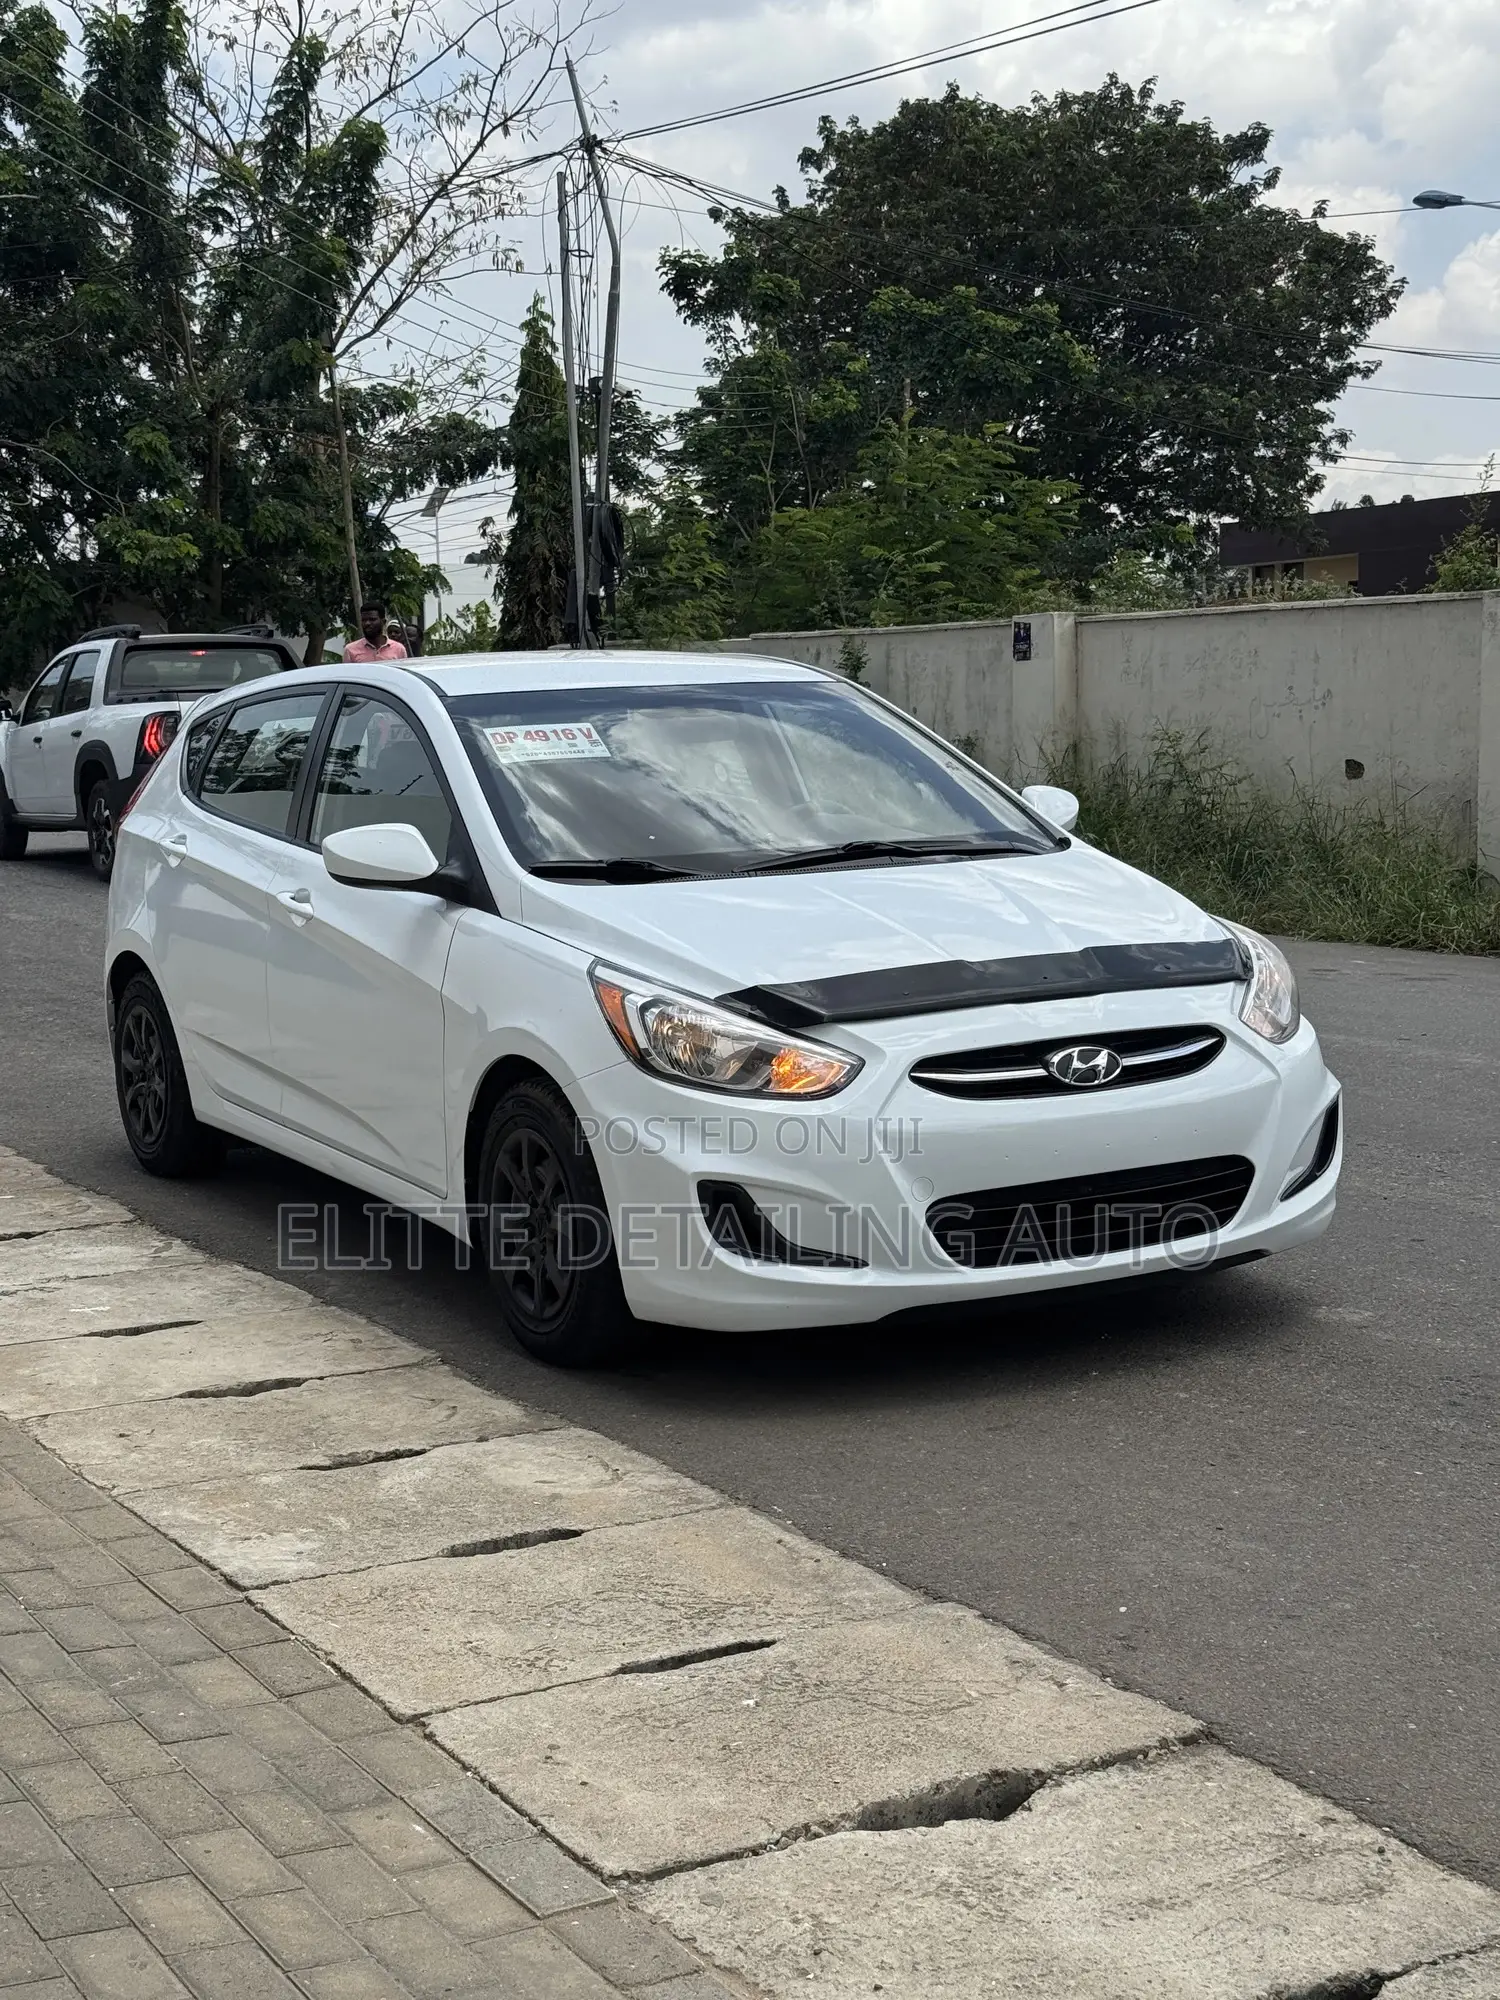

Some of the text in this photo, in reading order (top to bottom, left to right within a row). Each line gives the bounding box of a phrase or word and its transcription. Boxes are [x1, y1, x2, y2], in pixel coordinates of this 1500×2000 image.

[490, 727, 594, 745] DP 4916 V
